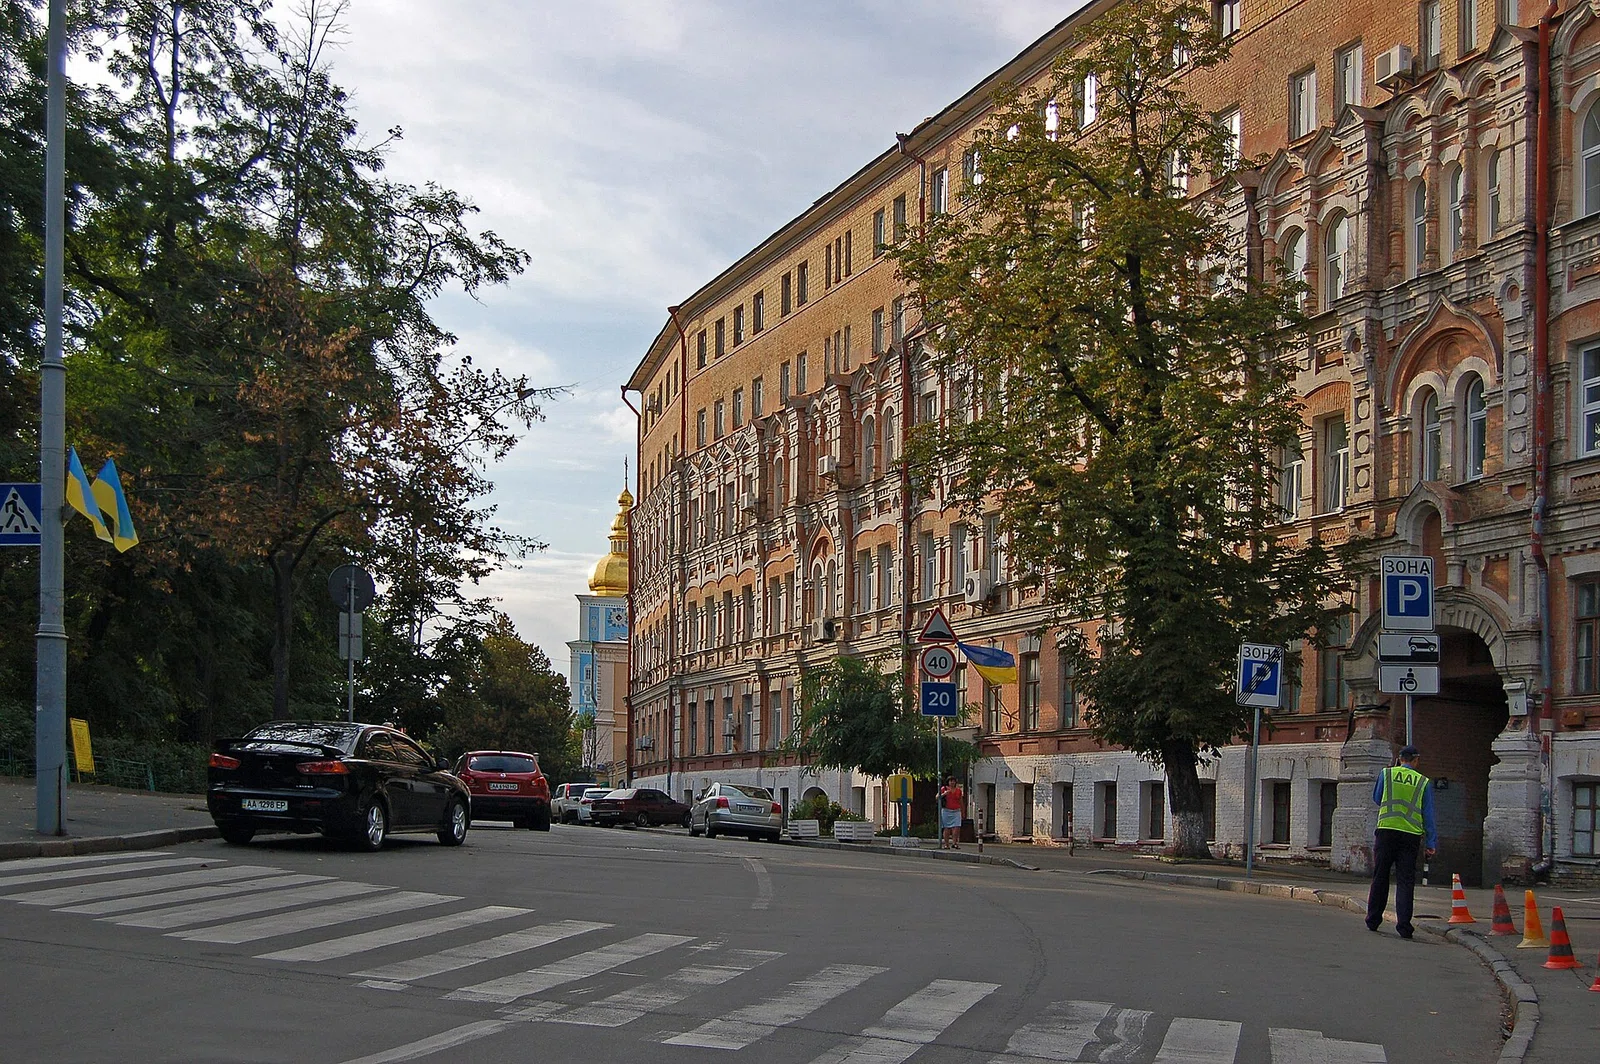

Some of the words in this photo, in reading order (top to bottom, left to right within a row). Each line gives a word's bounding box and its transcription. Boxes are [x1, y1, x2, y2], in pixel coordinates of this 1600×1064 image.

[1385, 560, 1430, 575] ЗОНА
[1399, 579, 1422, 613] P
[928, 656, 948, 669] 40
[928, 691, 950, 706] 20
